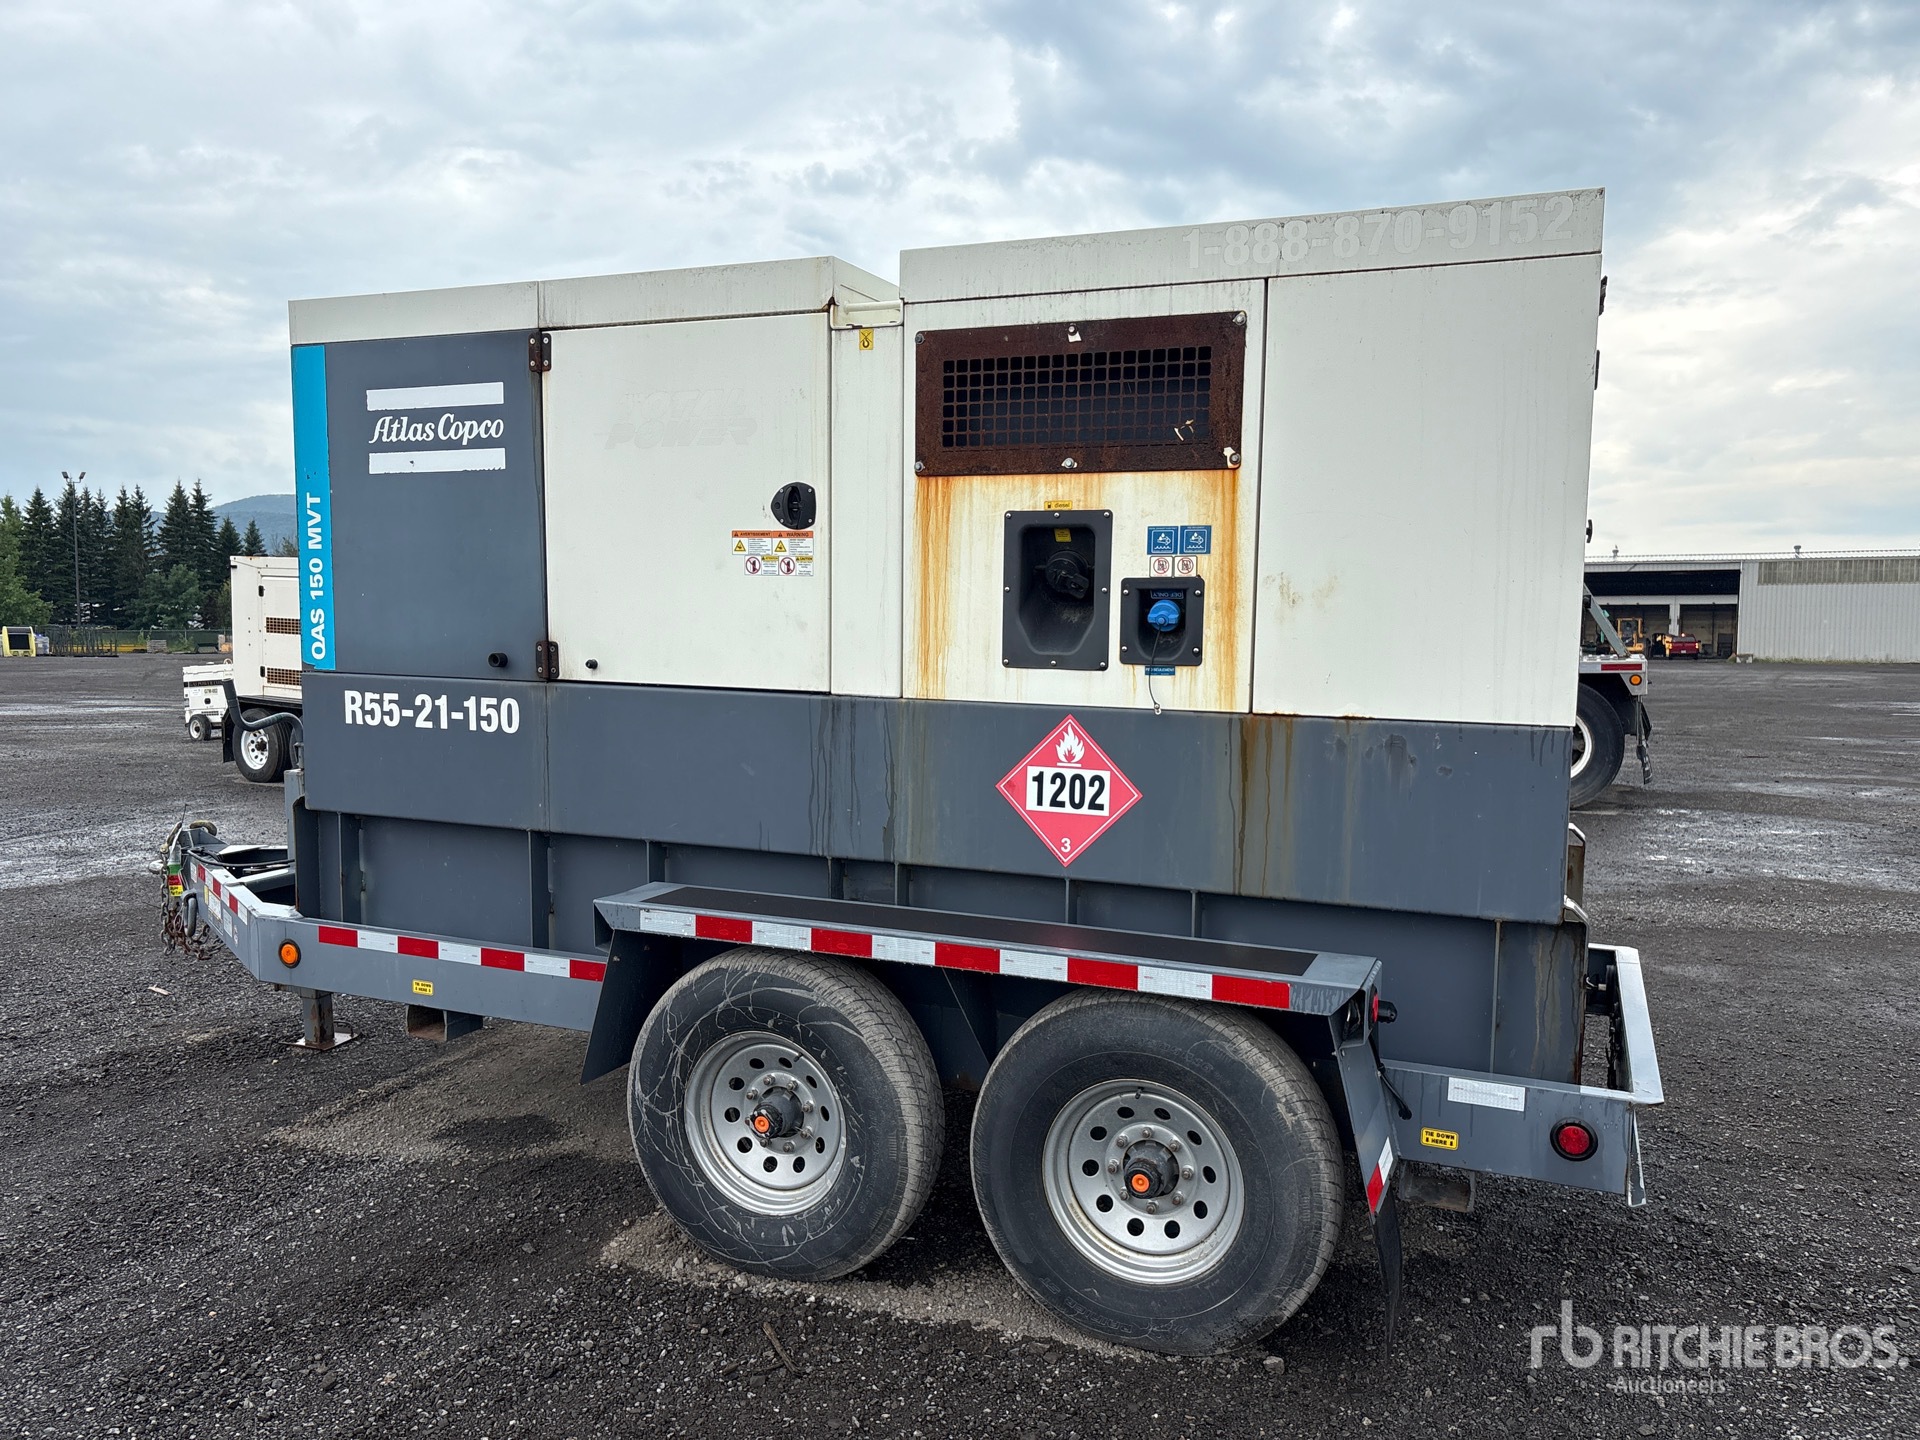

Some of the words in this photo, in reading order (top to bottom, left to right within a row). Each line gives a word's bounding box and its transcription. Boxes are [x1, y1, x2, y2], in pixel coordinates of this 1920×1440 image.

[1182, 195, 1573, 269] 1-888-870-9152
[368, 415, 435, 445] Atlas
[437, 412, 504, 445] Copco
[306, 492, 322, 550] MVT
[309, 557, 324, 600] 150
[311, 608, 326, 660] QAS
[343, 690, 520, 735] R55-21-150
[1032, 771, 1106, 811] 1202
[1060, 837, 1071, 853] 3
[1431, 1138, 1448, 1146] HERE
[1436, 1131, 1455, 1140] DOWN
